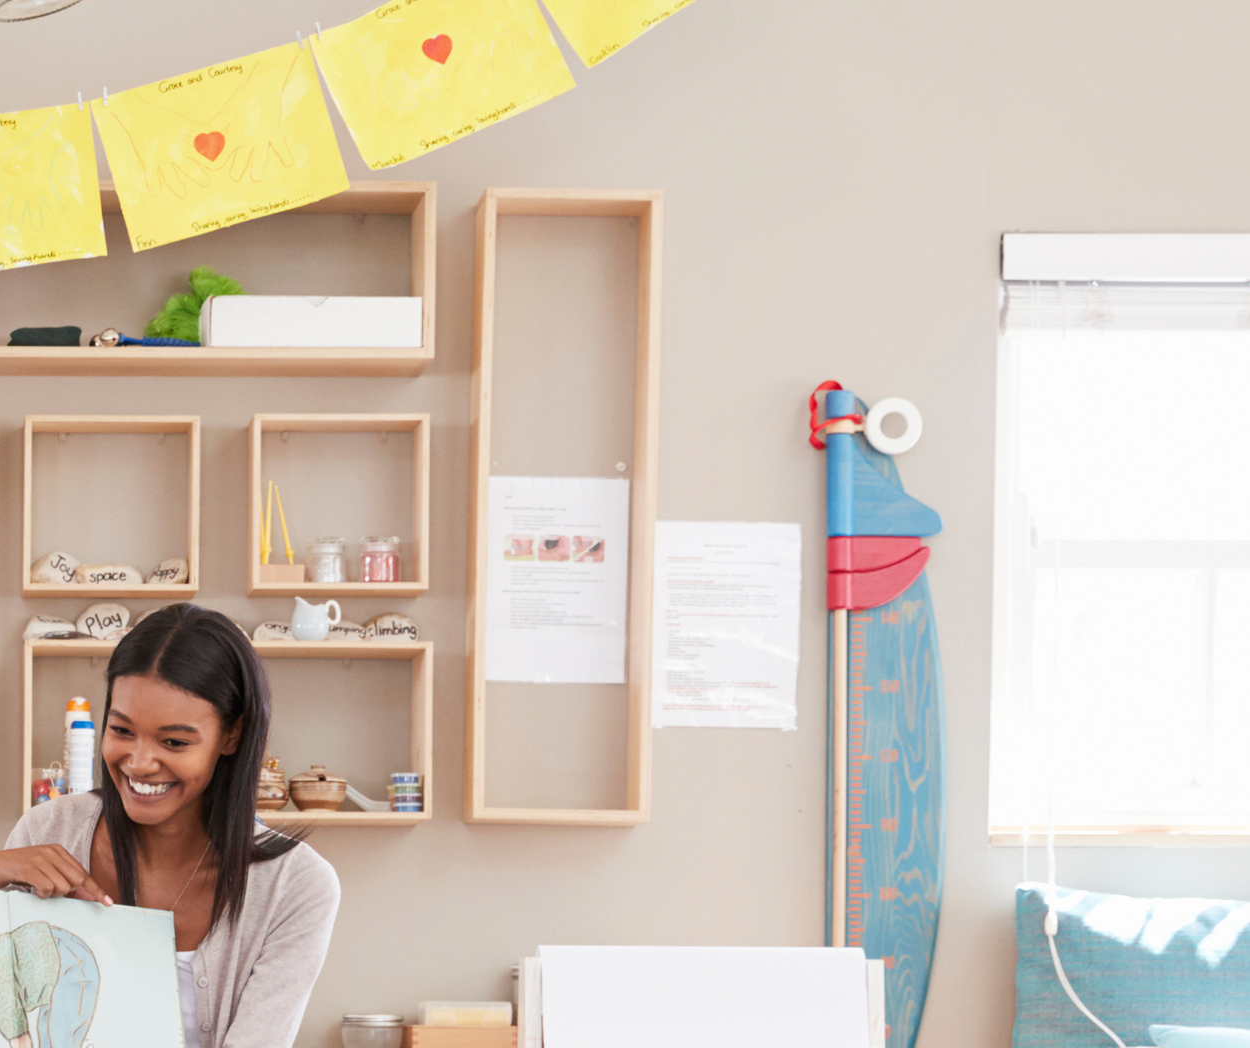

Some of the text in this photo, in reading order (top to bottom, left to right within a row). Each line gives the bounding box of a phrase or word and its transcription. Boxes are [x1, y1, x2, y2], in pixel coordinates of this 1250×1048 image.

[375, 4, 401, 19] Grace
[158, 64, 243, 93] Grace and Courtesy
[135, 234, 157, 250] Finn
[50, 554, 76, 583] Joy
[89, 571, 127, 584] space
[85, 612, 122, 636] Play
[881, 611, 900, 625] 140
[328, 623, 367, 639] umping
[881, 679, 900, 693] 130
[880, 748, 899, 762] 120
